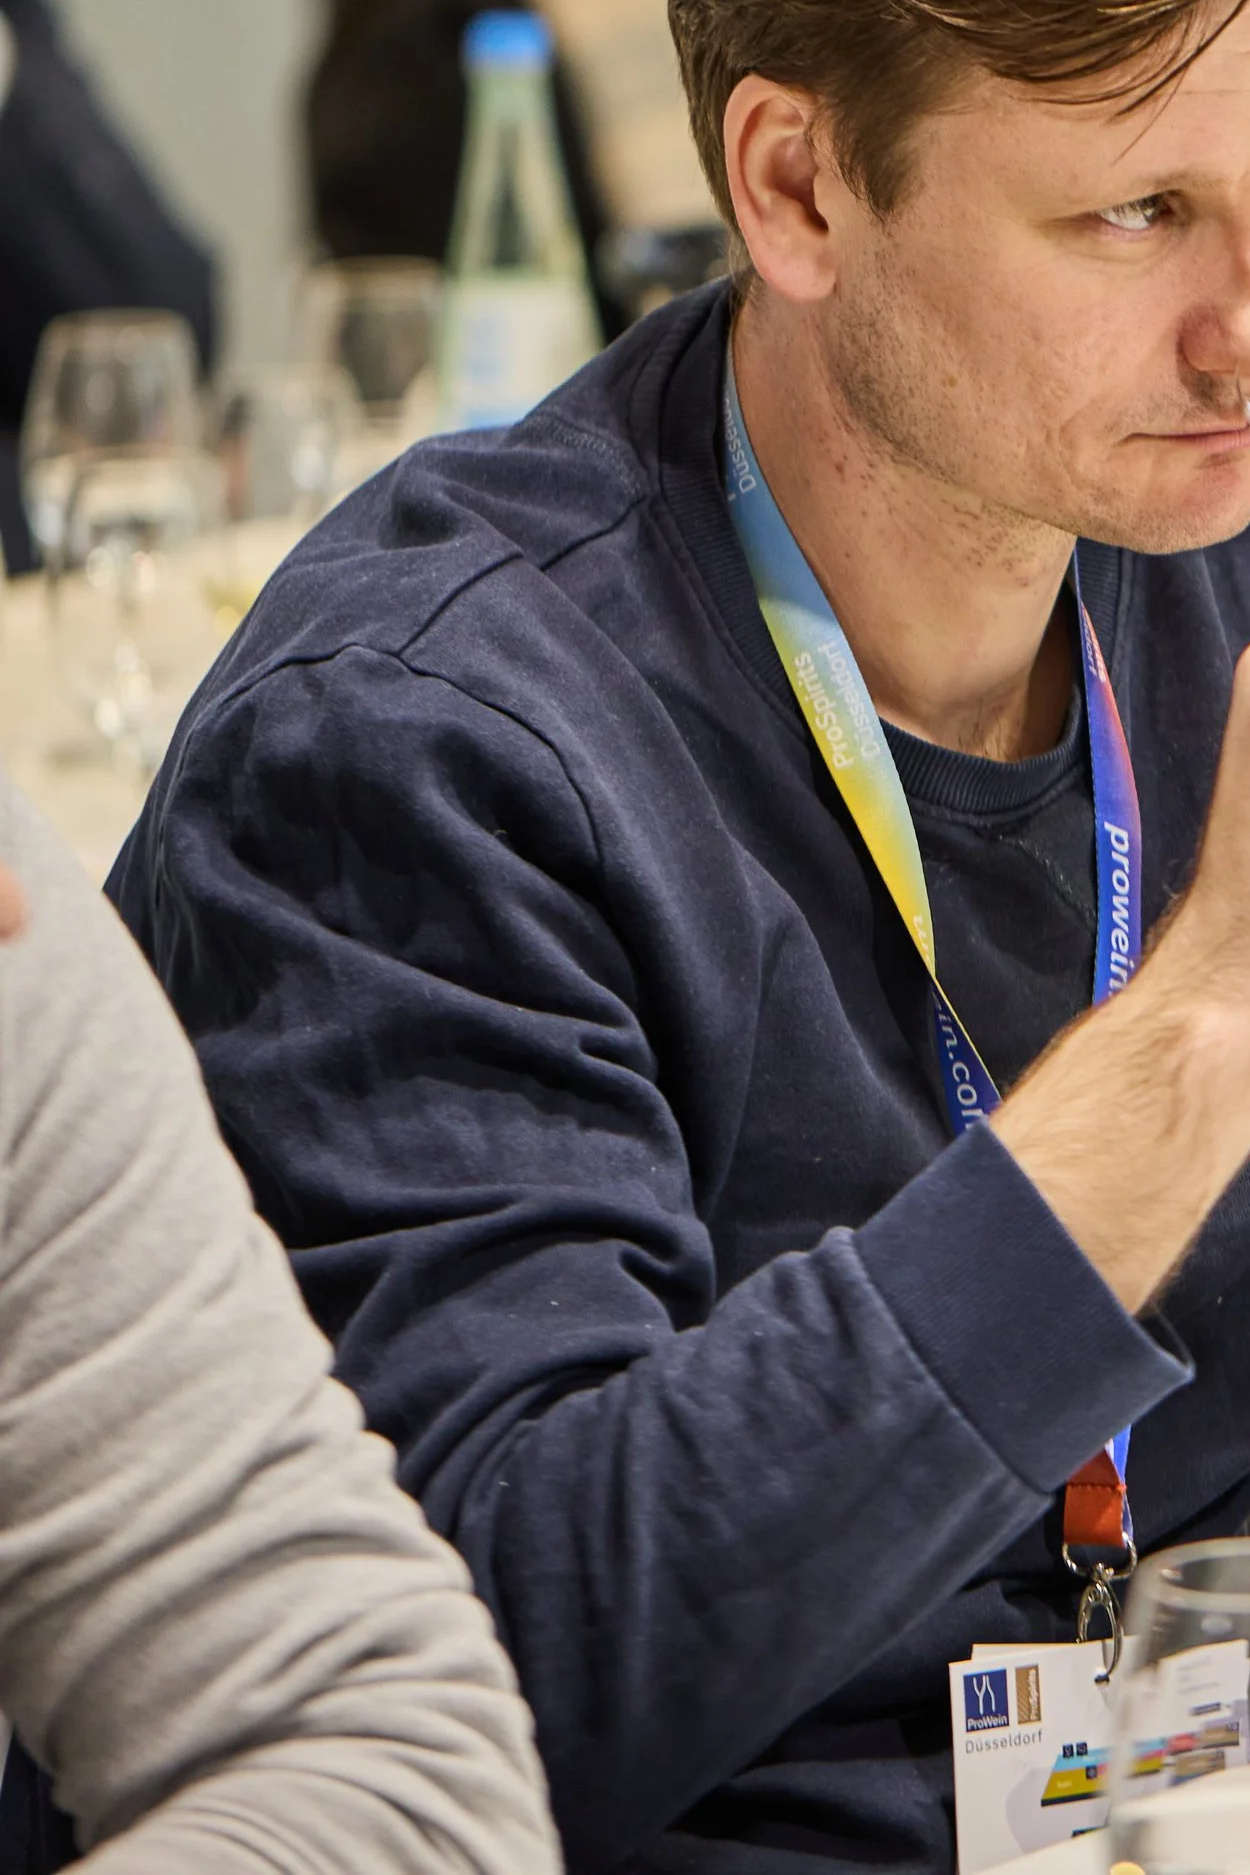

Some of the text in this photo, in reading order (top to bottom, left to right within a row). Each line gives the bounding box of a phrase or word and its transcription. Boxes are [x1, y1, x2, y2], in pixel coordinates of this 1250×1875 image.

[795, 651, 854, 770] ProSpirits
[818, 639, 880, 760] Düsseldorf
[1104, 821, 1135, 998] prowein.
[965, 1728, 1043, 1755] Düsseldorf
[967, 1714, 1008, 1731] ProWein
